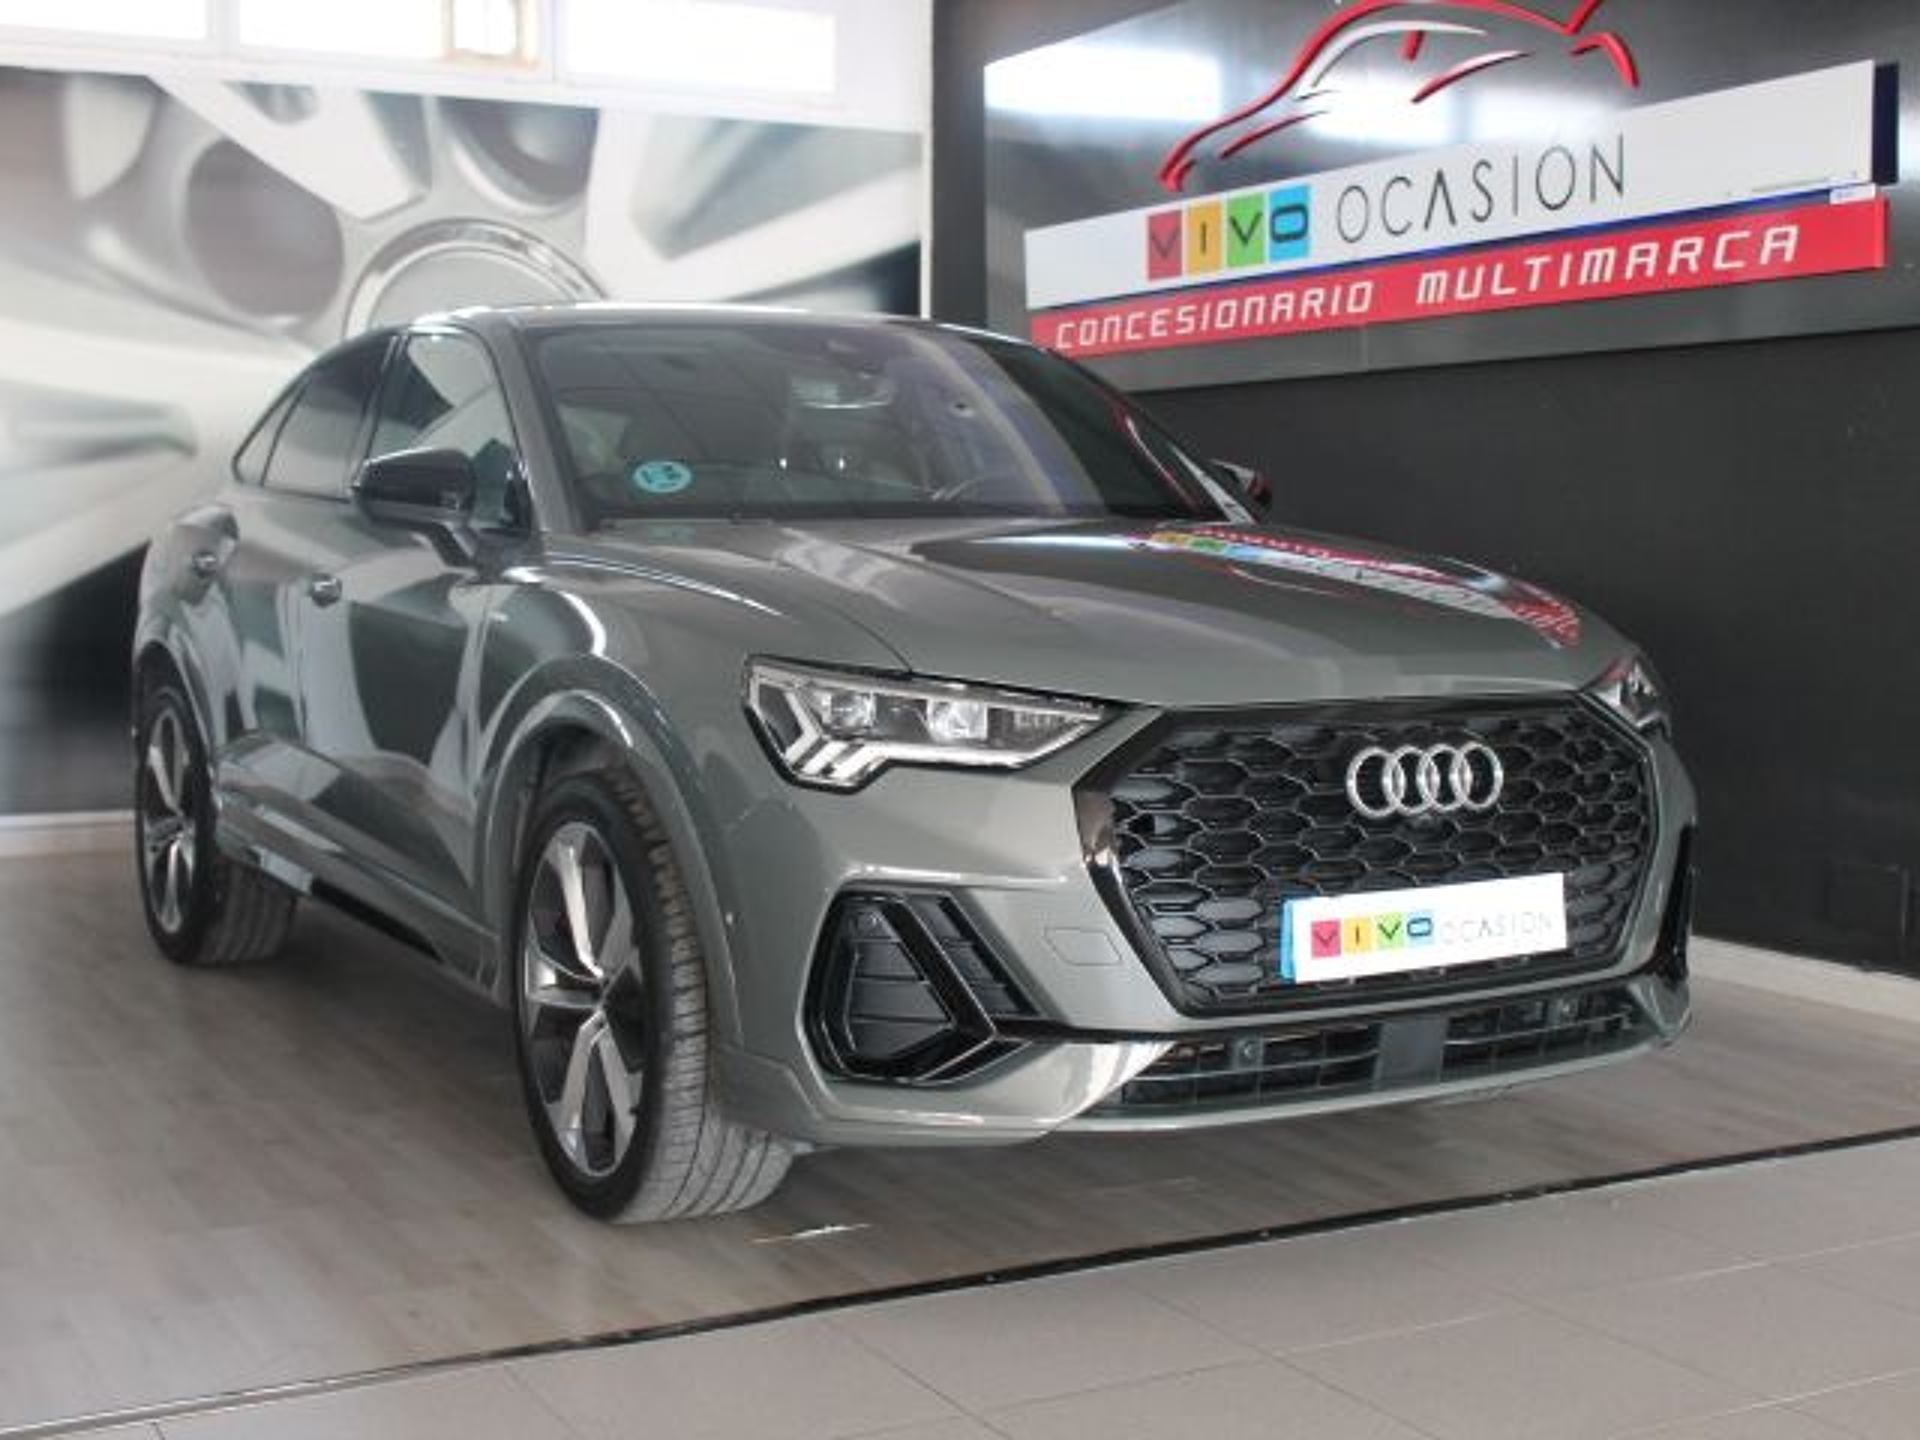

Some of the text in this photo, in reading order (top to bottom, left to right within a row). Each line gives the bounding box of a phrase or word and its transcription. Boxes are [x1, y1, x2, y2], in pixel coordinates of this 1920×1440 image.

[1149, 132, 1624, 263] VIVO OCASION
[1056, 224, 1799, 349] CONCESIONARIO MULTIMARCA
[1312, 911, 1553, 952] VIVO OCASION
